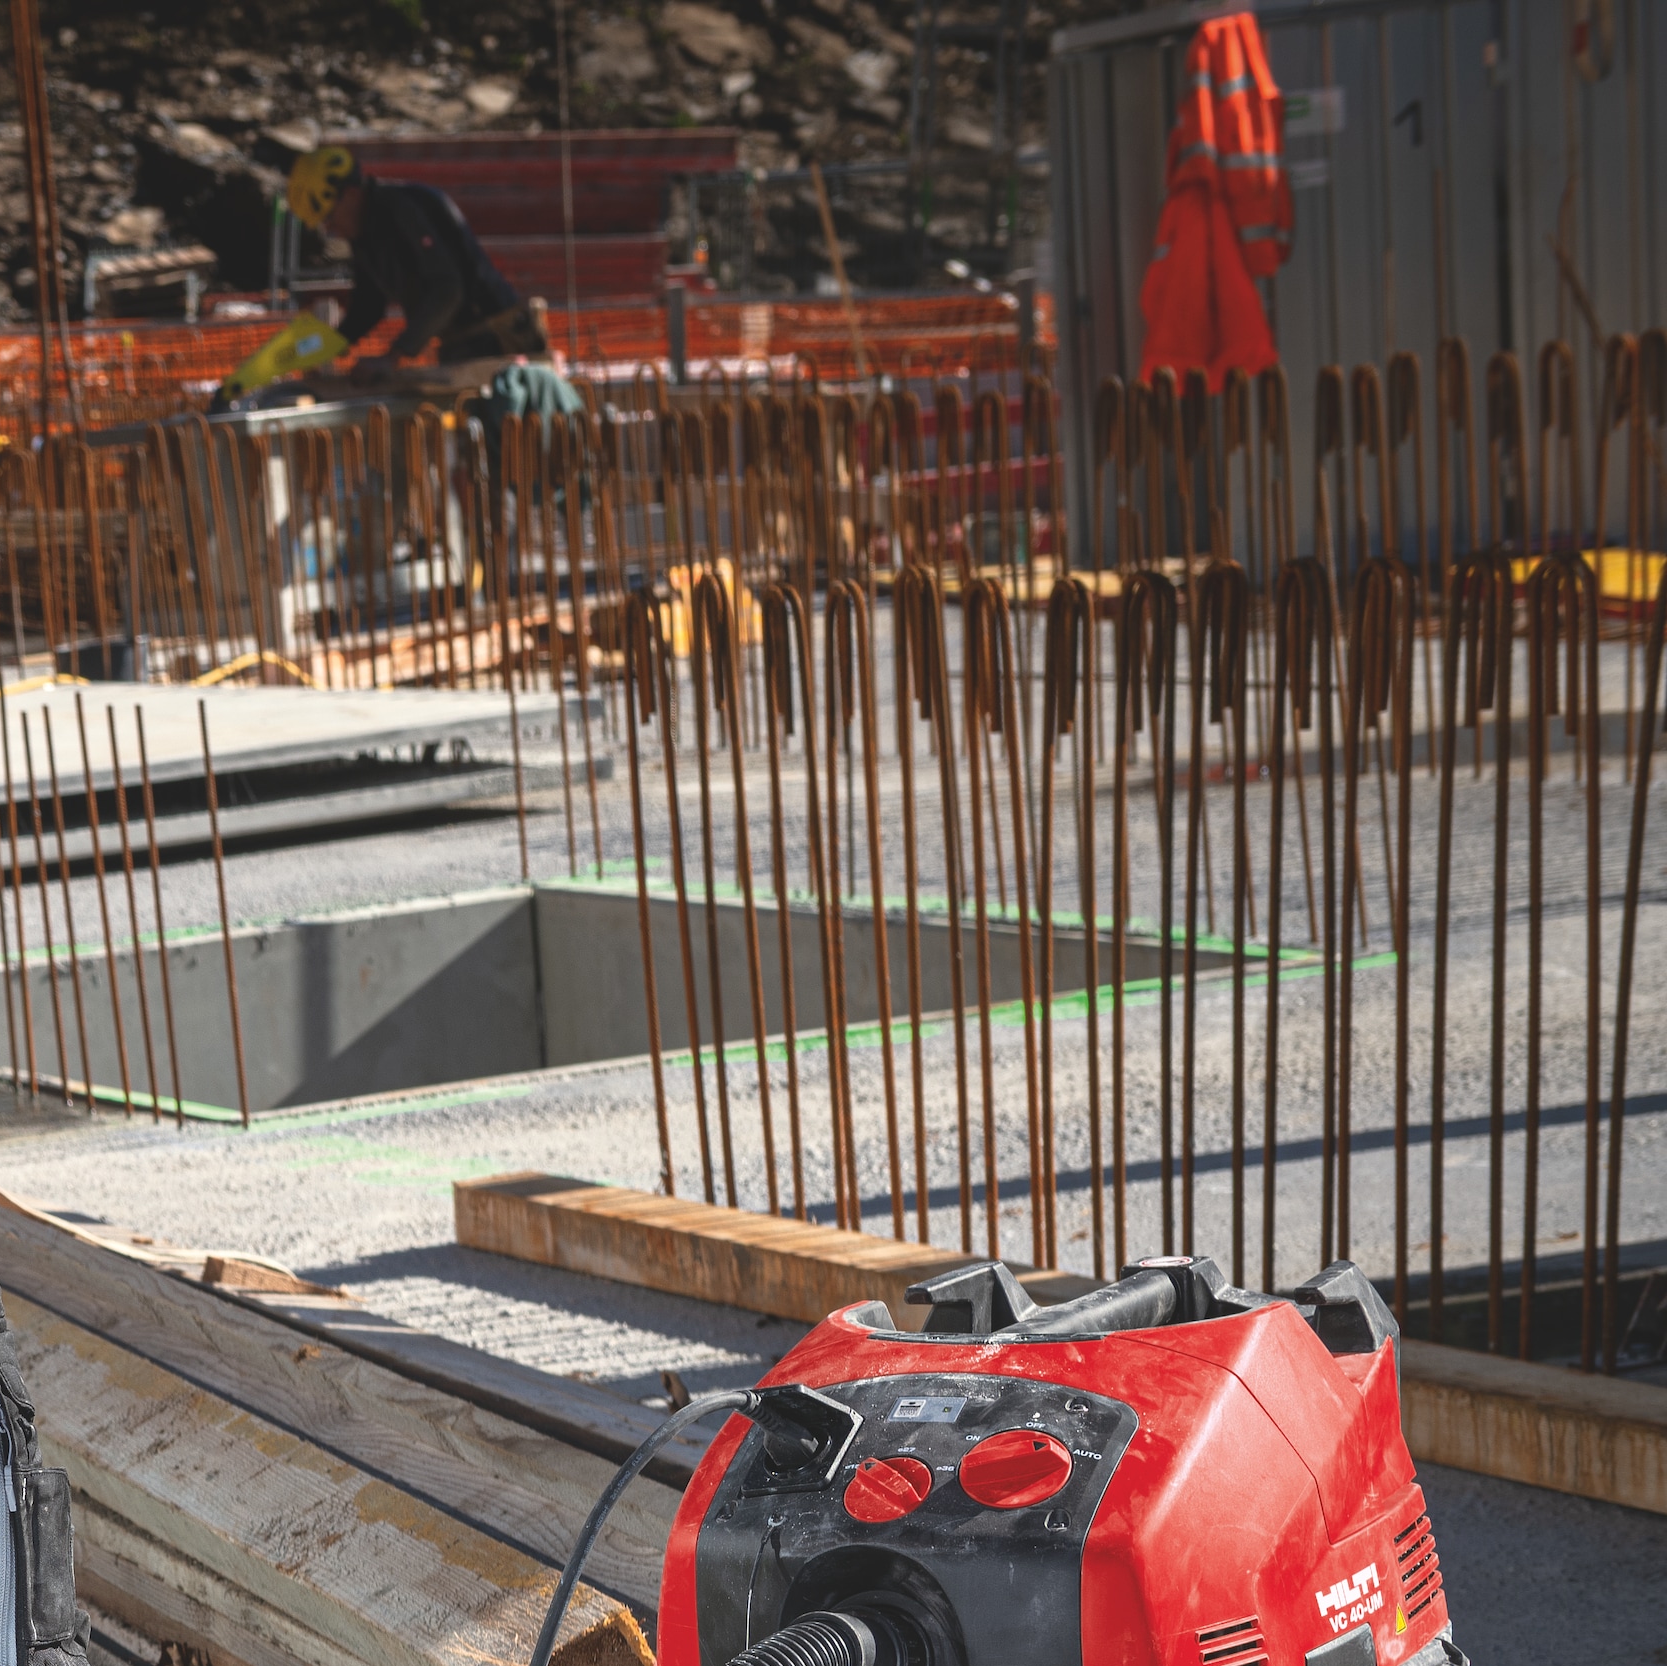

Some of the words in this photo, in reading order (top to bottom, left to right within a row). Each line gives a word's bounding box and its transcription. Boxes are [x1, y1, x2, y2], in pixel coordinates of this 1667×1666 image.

[1025, 1421, 1046, 1429] OFF
[965, 1434, 981, 1442] ON
[1072, 1449, 1102, 1460] AUTO
[1315, 1562, 1380, 1617] HILTI
[1329, 1612, 1348, 1633] VC
[1350, 1590, 1384, 1623] 40-UM
